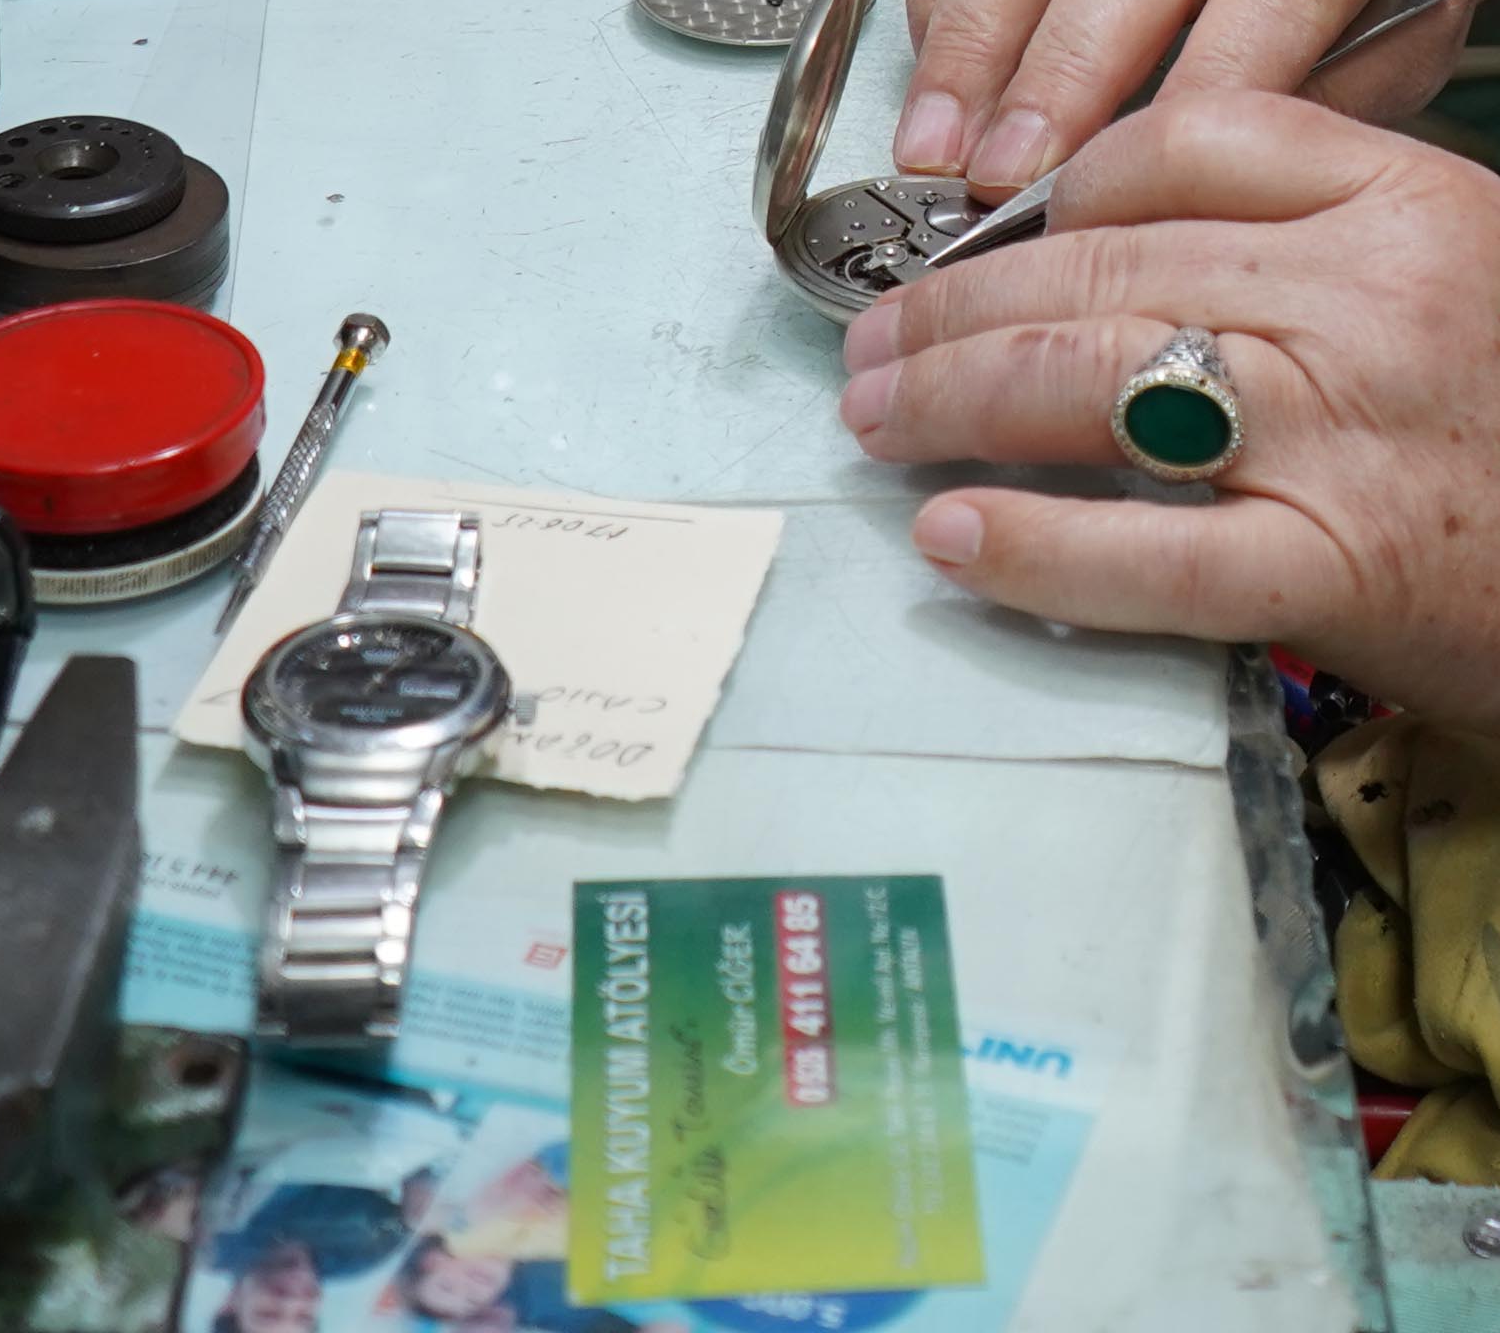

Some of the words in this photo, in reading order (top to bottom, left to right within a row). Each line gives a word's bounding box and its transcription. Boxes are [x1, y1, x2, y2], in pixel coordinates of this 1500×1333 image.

[783, 892, 821, 932] 85
[597, 891, 651, 1044] ATÖLYESİ
[788, 979, 828, 1037] 411
[962, 1036, 1073, 1079] UNI
[605, 1046, 651, 1174] KUYUM
[605, 1179, 650, 1281] TAHA
